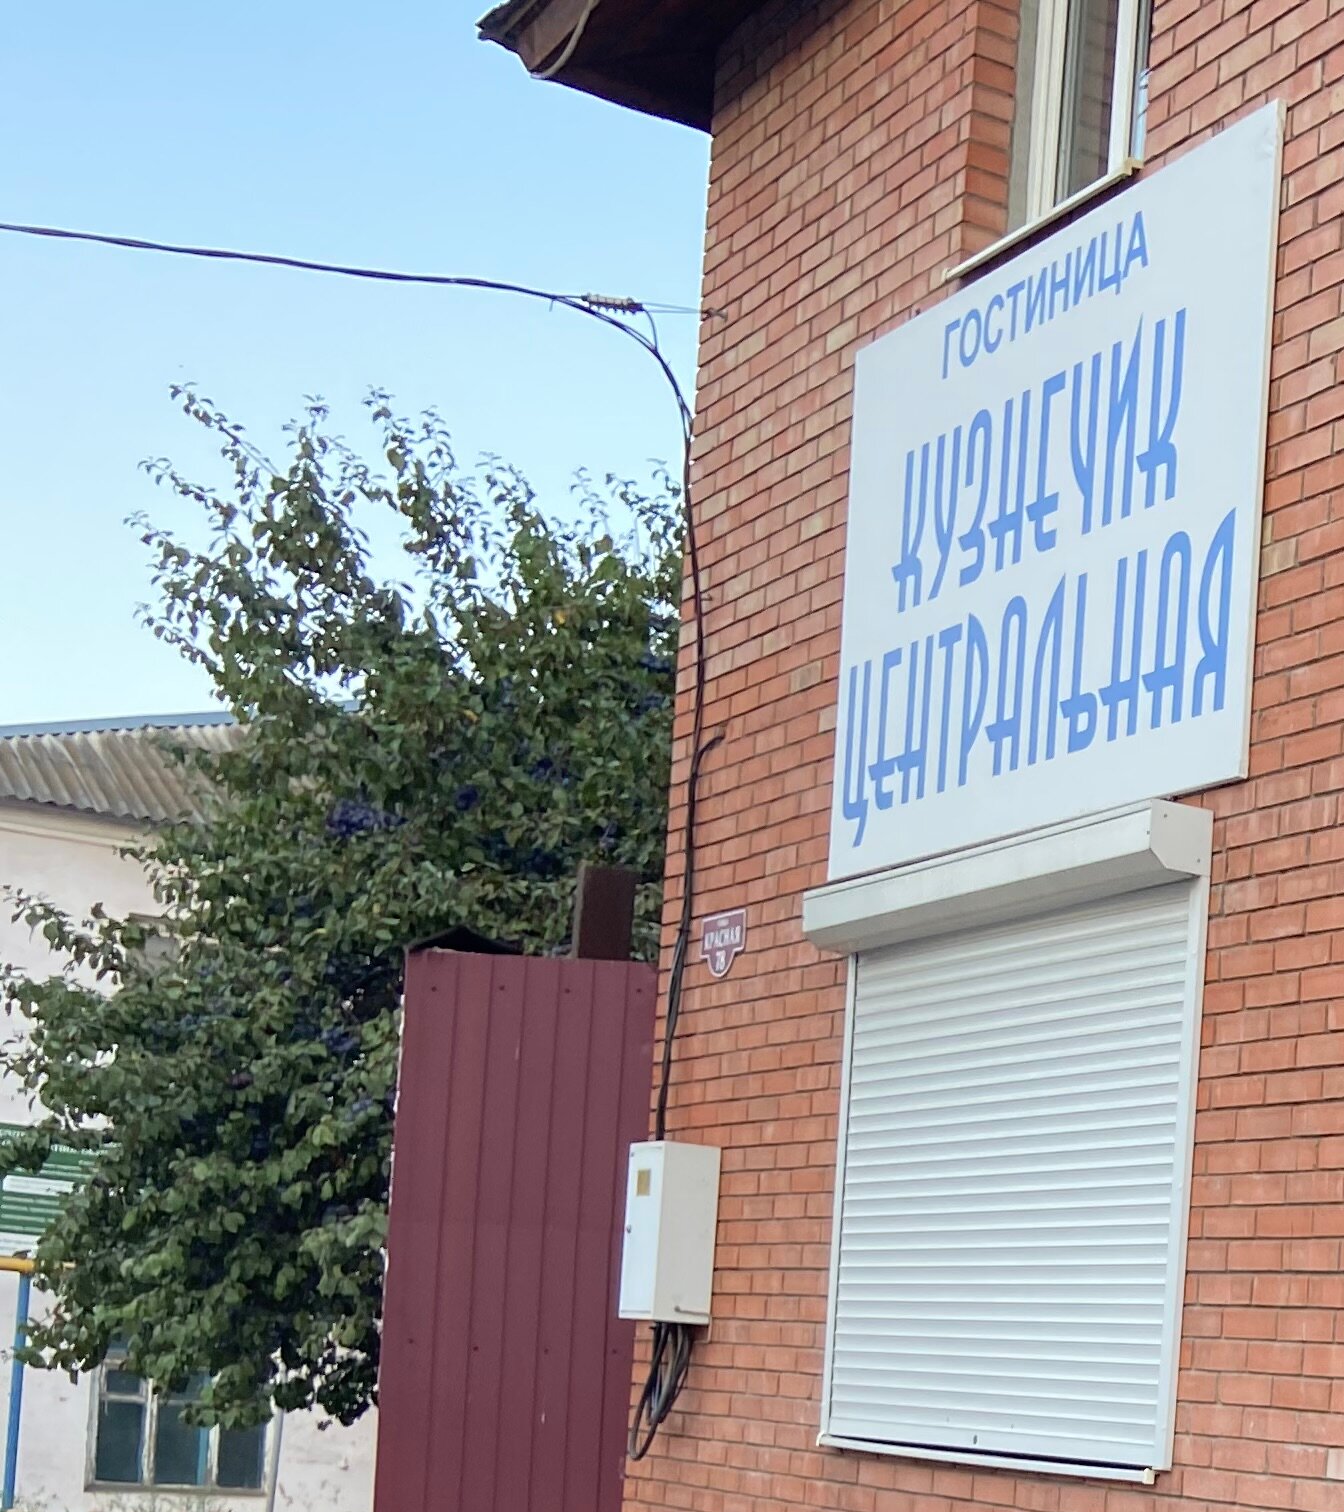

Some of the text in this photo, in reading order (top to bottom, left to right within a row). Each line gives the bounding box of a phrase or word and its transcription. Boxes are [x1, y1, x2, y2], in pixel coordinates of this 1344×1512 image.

[943, 210, 1149, 380] ГОСТИНИЦА
[892, 307, 1187, 614] КУЗНЕЧИК
[841, 506, 1238, 848] ЦЕНТРАЛЬНАЯ
